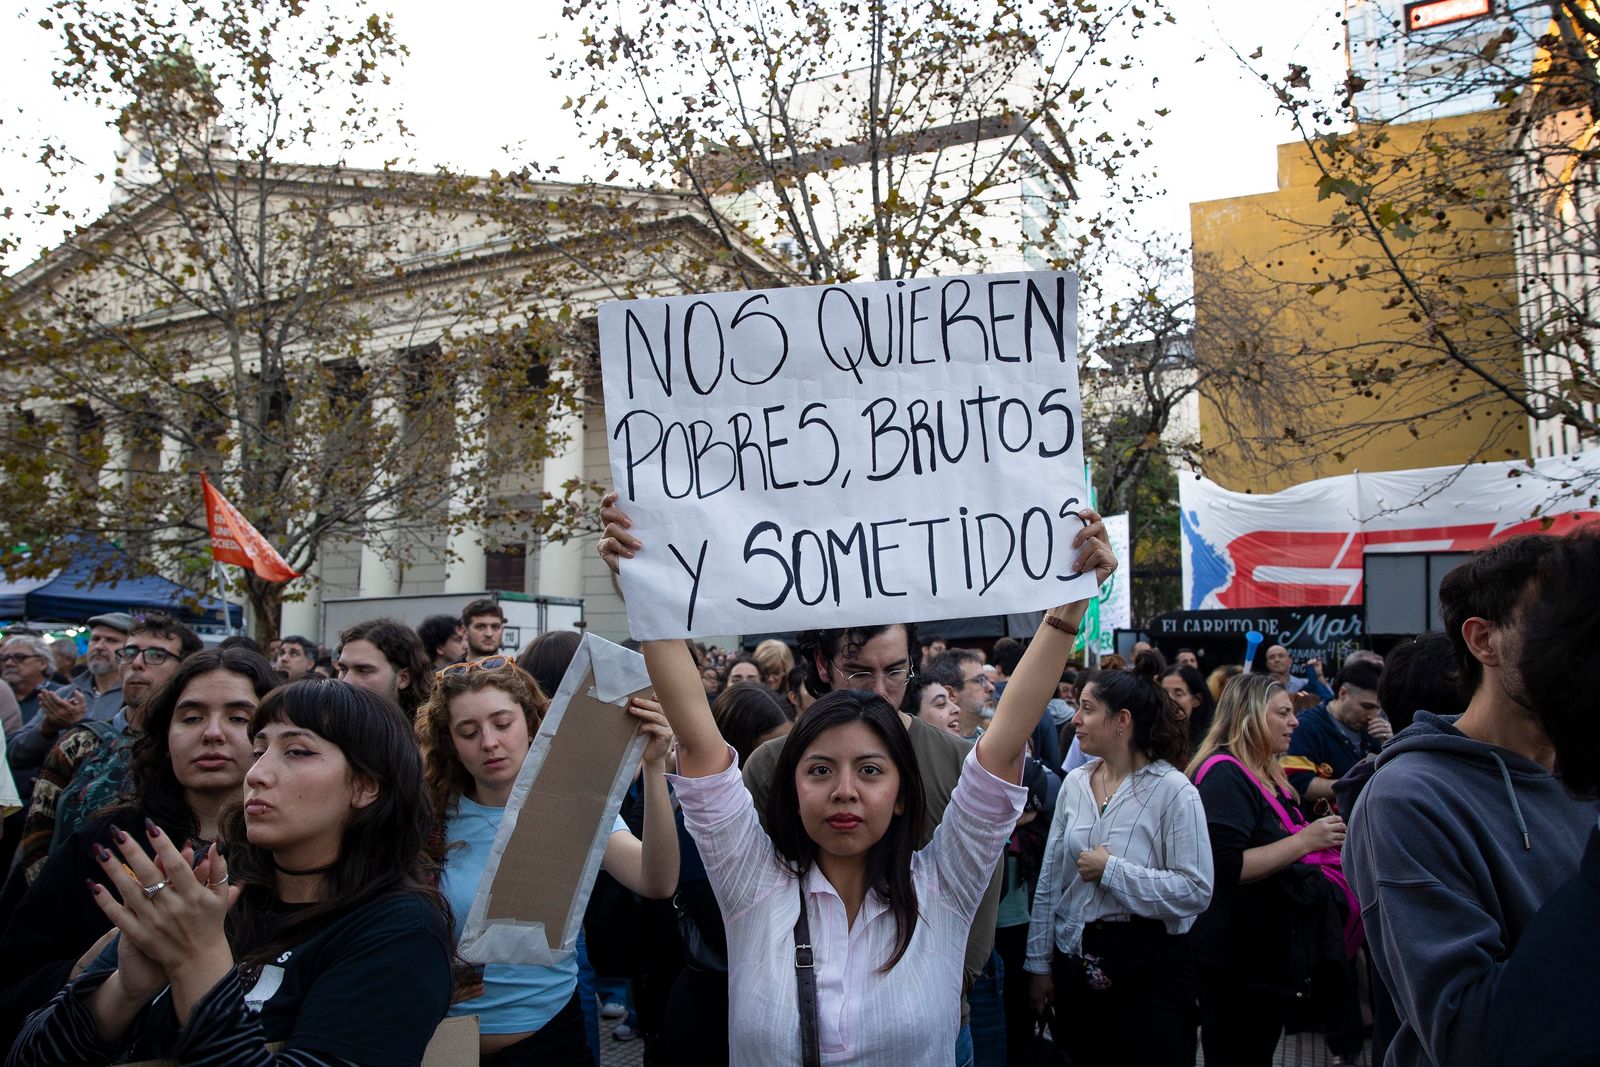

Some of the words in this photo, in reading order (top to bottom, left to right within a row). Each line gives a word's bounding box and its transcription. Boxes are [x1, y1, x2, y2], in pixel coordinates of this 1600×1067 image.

[625, 294, 789, 400] NOS
[817, 276, 1066, 385] QUIEREN
[613, 402, 852, 502] POBRES,
[861, 385, 1075, 482] BRUTOS
[667, 539, 709, 632] Y
[736, 497, 1086, 611] SOMETIDOS
[1183, 619, 1254, 633] CARRITO
[1258, 619, 1280, 636] DE
